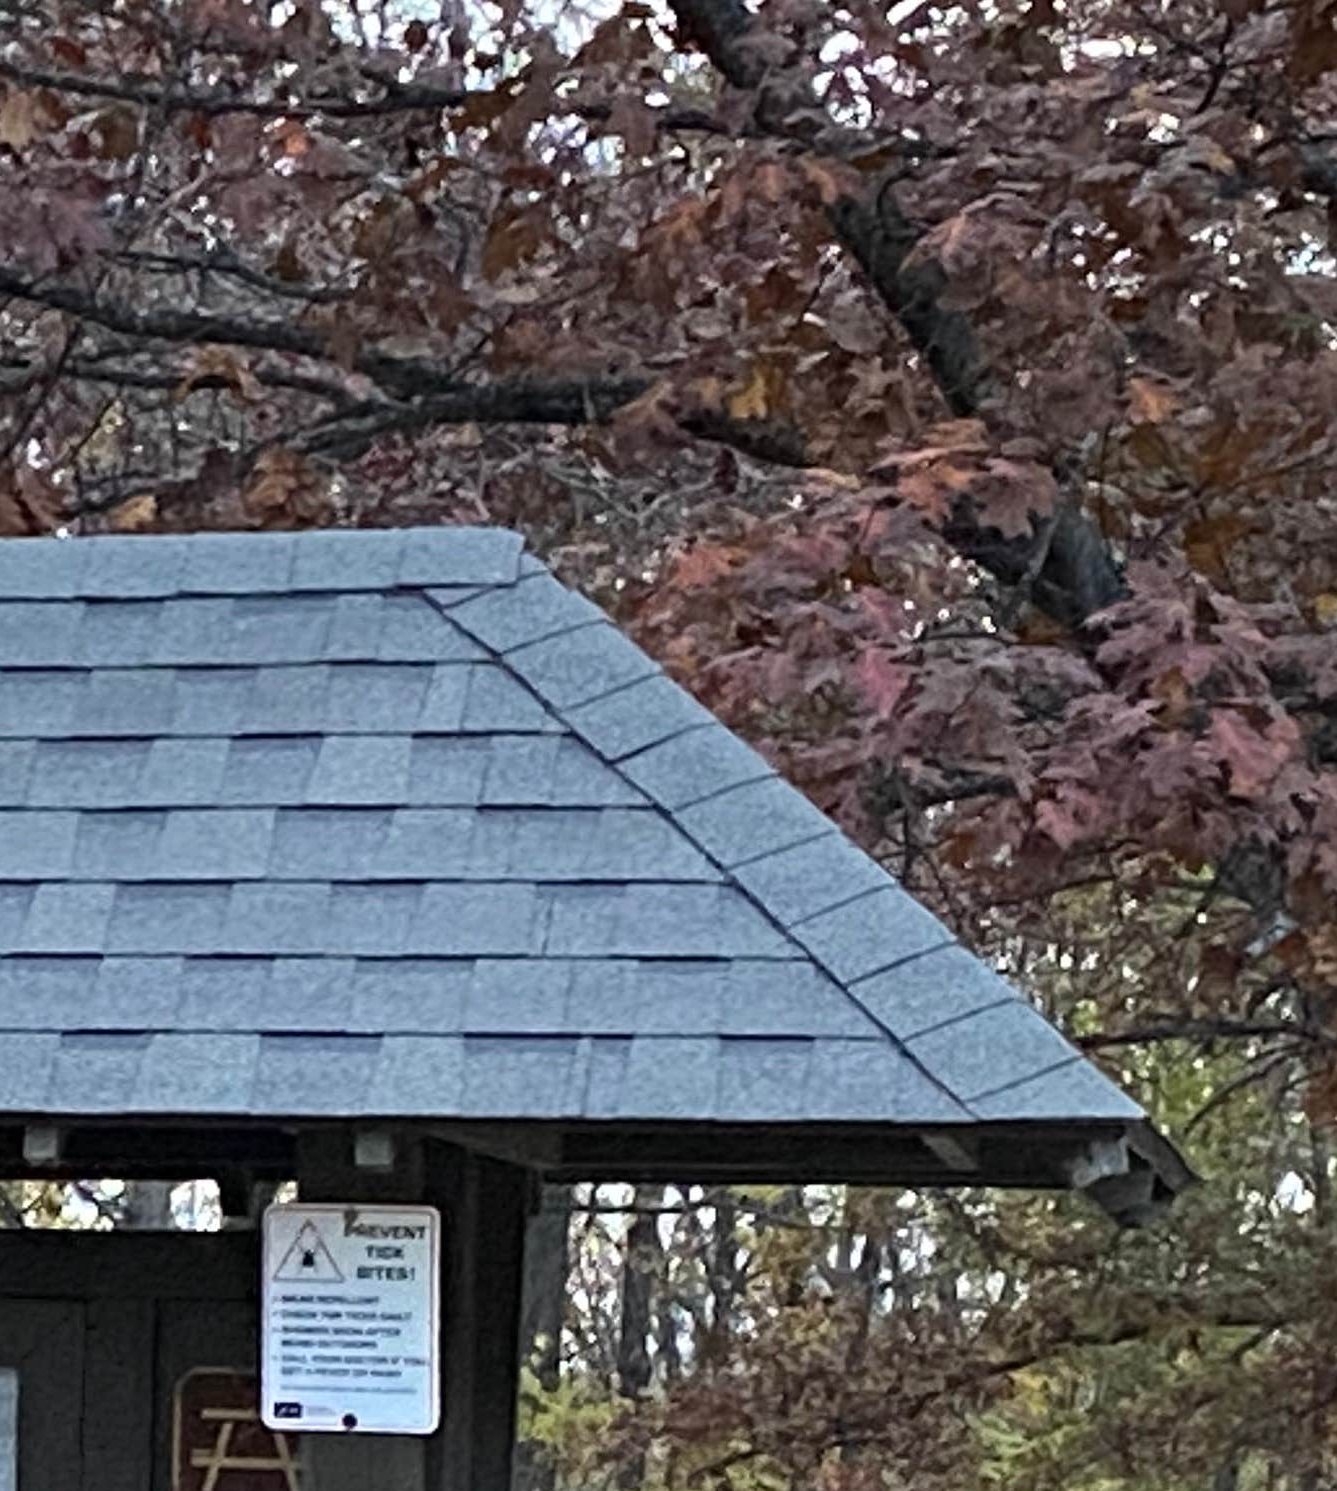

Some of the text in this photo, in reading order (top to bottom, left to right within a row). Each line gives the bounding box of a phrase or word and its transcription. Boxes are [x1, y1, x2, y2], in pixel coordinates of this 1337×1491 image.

[344, 1222, 426, 1240] PREVENT
[366, 1245, 405, 1260] TICK
[357, 1266, 415, 1281] BITES!
